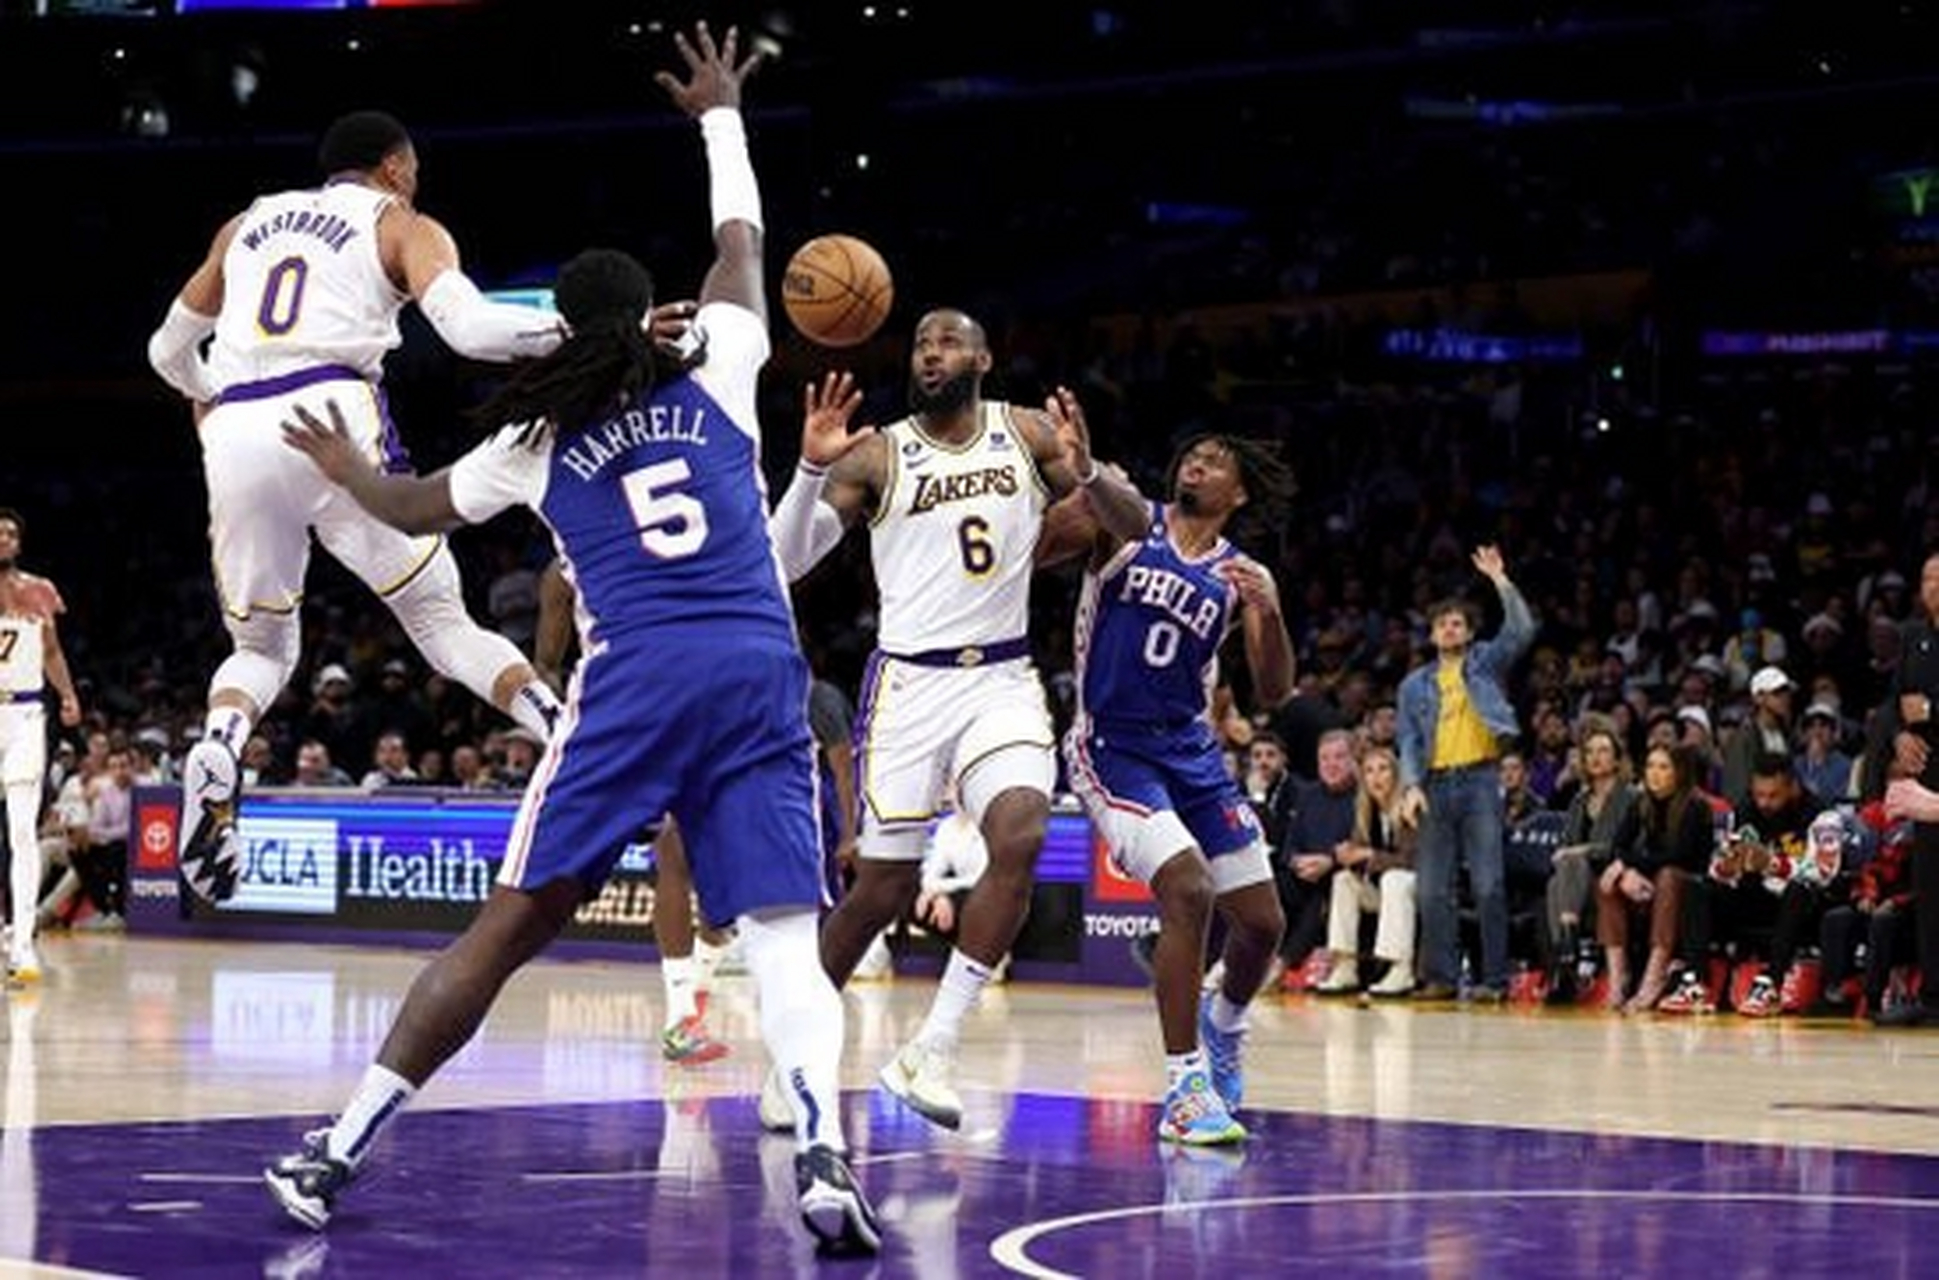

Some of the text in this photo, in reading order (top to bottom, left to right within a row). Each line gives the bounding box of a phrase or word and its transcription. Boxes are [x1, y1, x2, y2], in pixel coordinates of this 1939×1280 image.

[257, 254, 308, 337] 0
[561, 405, 707, 482] HARRELL
[620, 456, 711, 560] 5
[906, 464, 1020, 517] LAKERS
[957, 513, 996, 577] 6
[1119, 564, 1221, 640] PHILA
[1143, 619, 1182, 669] 0
[346, 835, 489, 901] Health
[1084, 914, 1163, 937] TOYOTA
